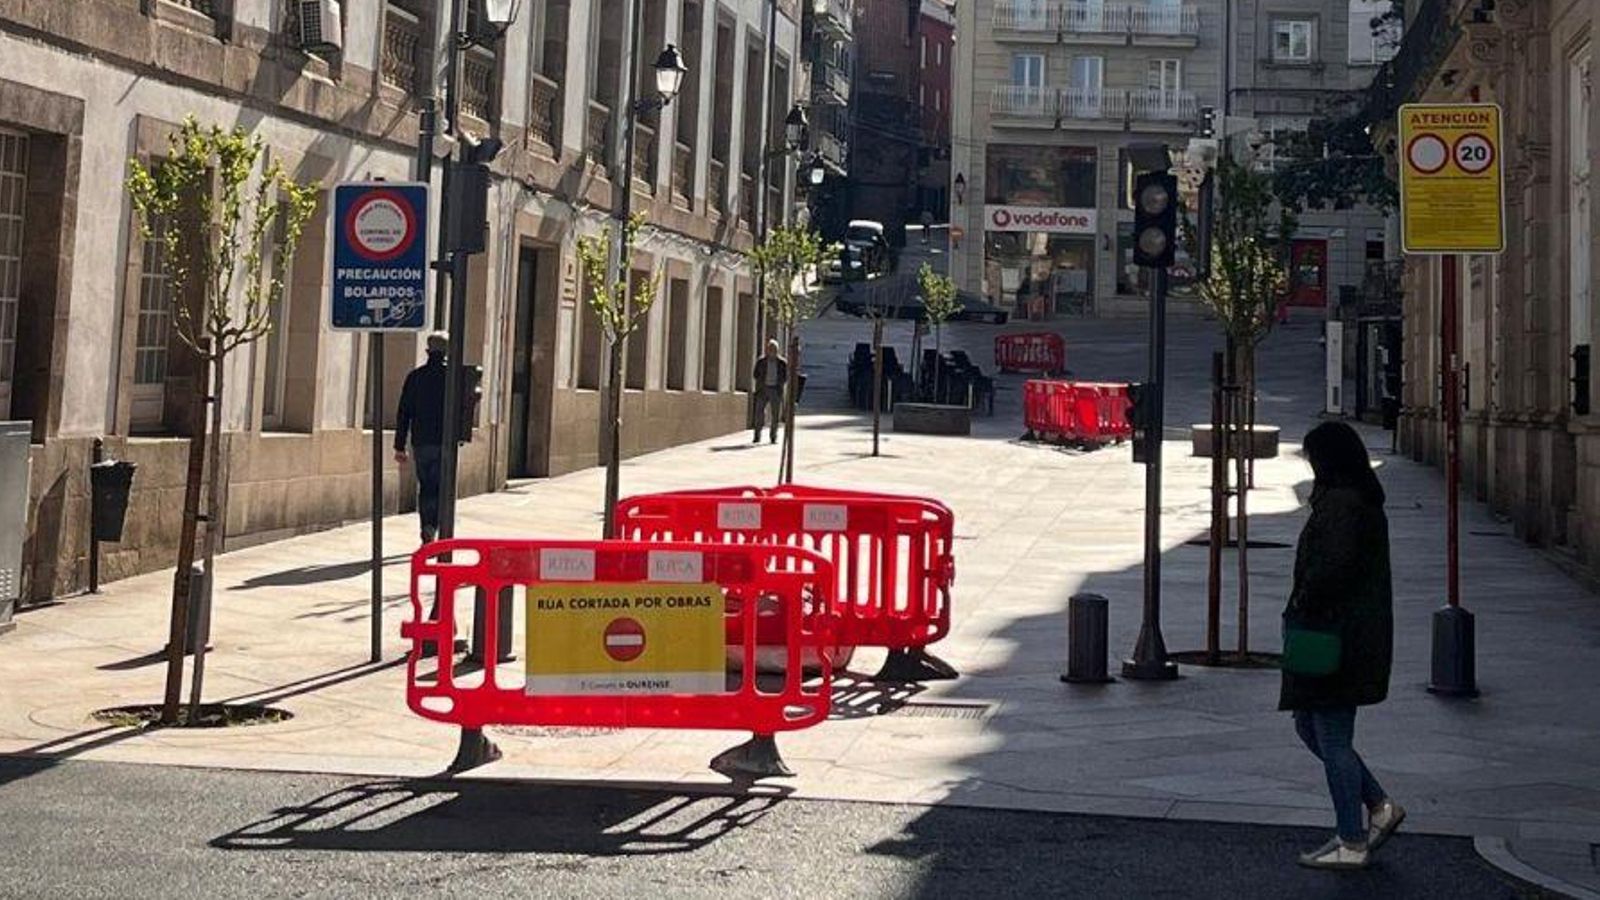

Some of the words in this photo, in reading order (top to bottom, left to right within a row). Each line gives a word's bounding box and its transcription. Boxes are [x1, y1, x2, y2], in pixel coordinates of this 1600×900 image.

[1411, 112, 1489, 124] ATENCIÓN
[1461, 146, 1487, 161] 20
[1013, 211, 1089, 227] vodafone
[337, 268, 422, 281] PRECAUCIÓN
[344, 286, 415, 298] BOLARDOS
[570, 597, 630, 610] CORTADA
[635, 597, 662, 608] POR
[666, 595, 711, 608] OBRAS
[626, 679, 670, 690] OURENSE
